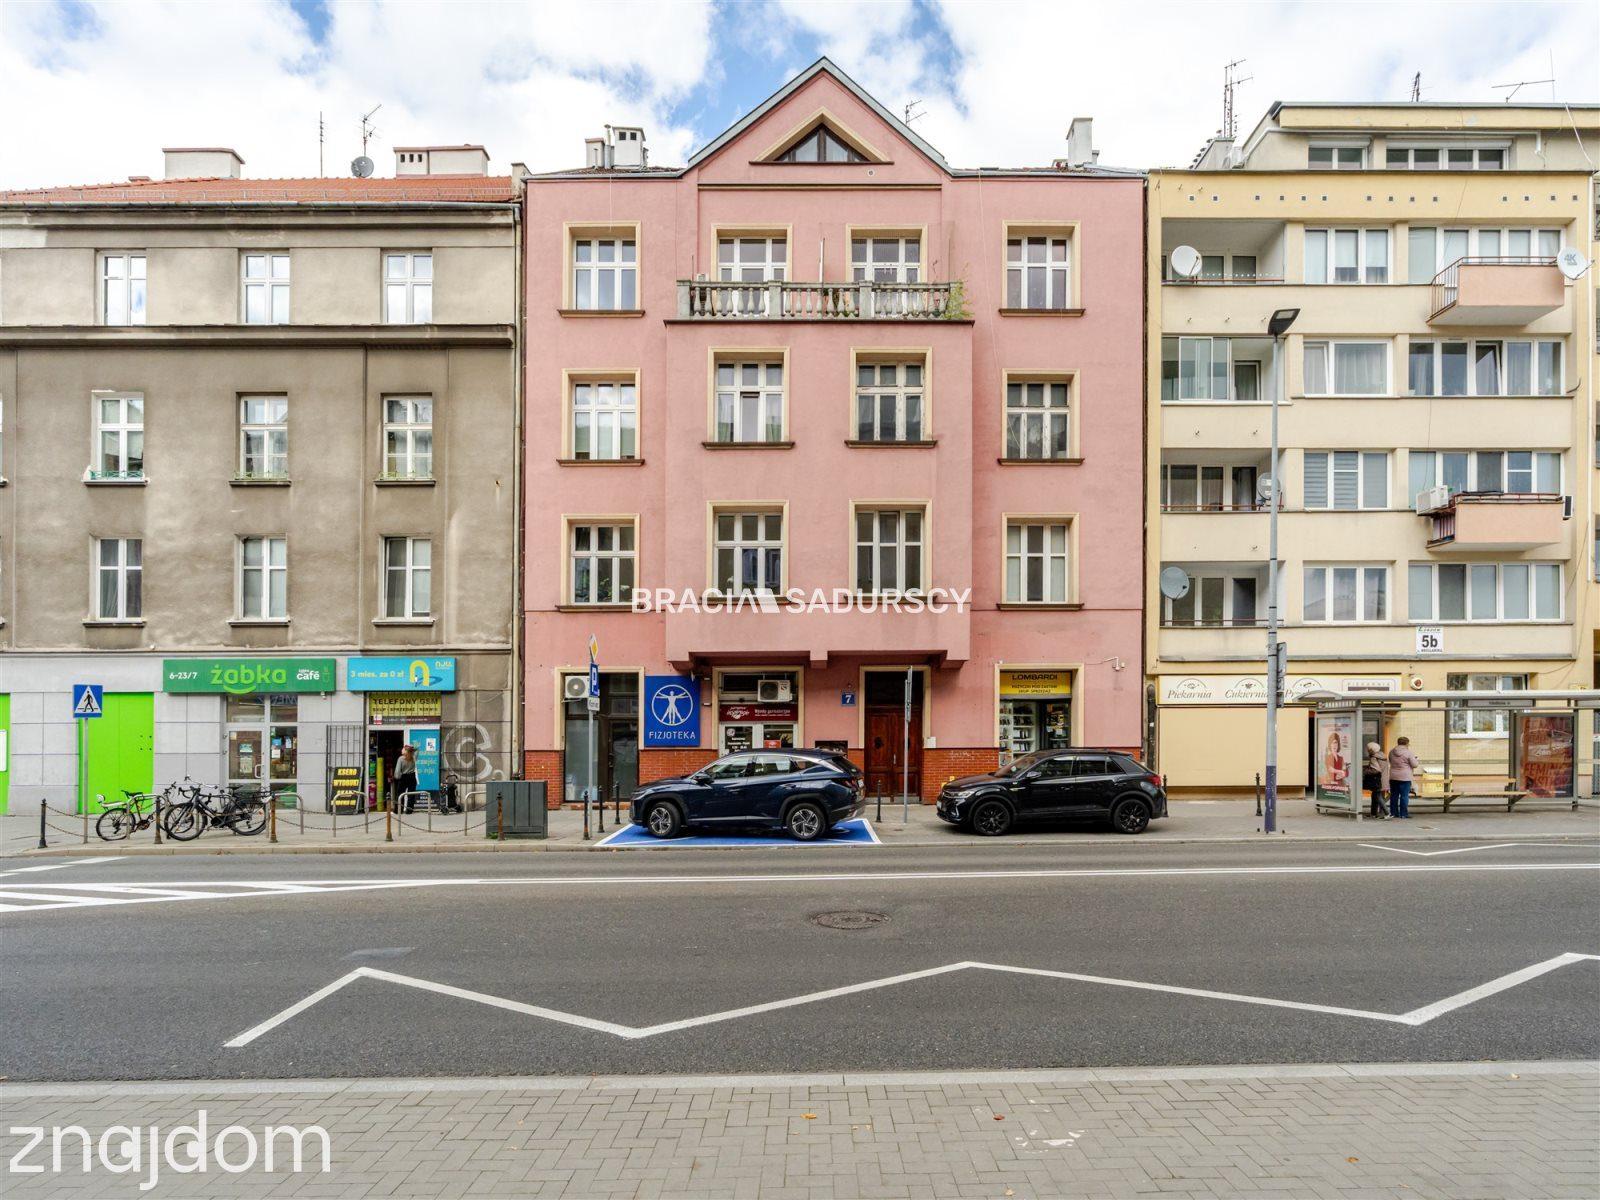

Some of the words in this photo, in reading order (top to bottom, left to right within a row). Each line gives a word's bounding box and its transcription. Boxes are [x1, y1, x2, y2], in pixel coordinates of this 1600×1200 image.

[1421, 634, 1438, 648] 5b
[169, 672, 199, 680] 6-23/7
[210, 664, 288, 686] żabka
[296, 669, 321, 681] café
[845, 694, 852, 704] 7
[1168, 689, 1213, 699] Piekarnia
[648, 731, 696, 740] FIZJOTEKA
[337, 768, 358, 776] KSERO
